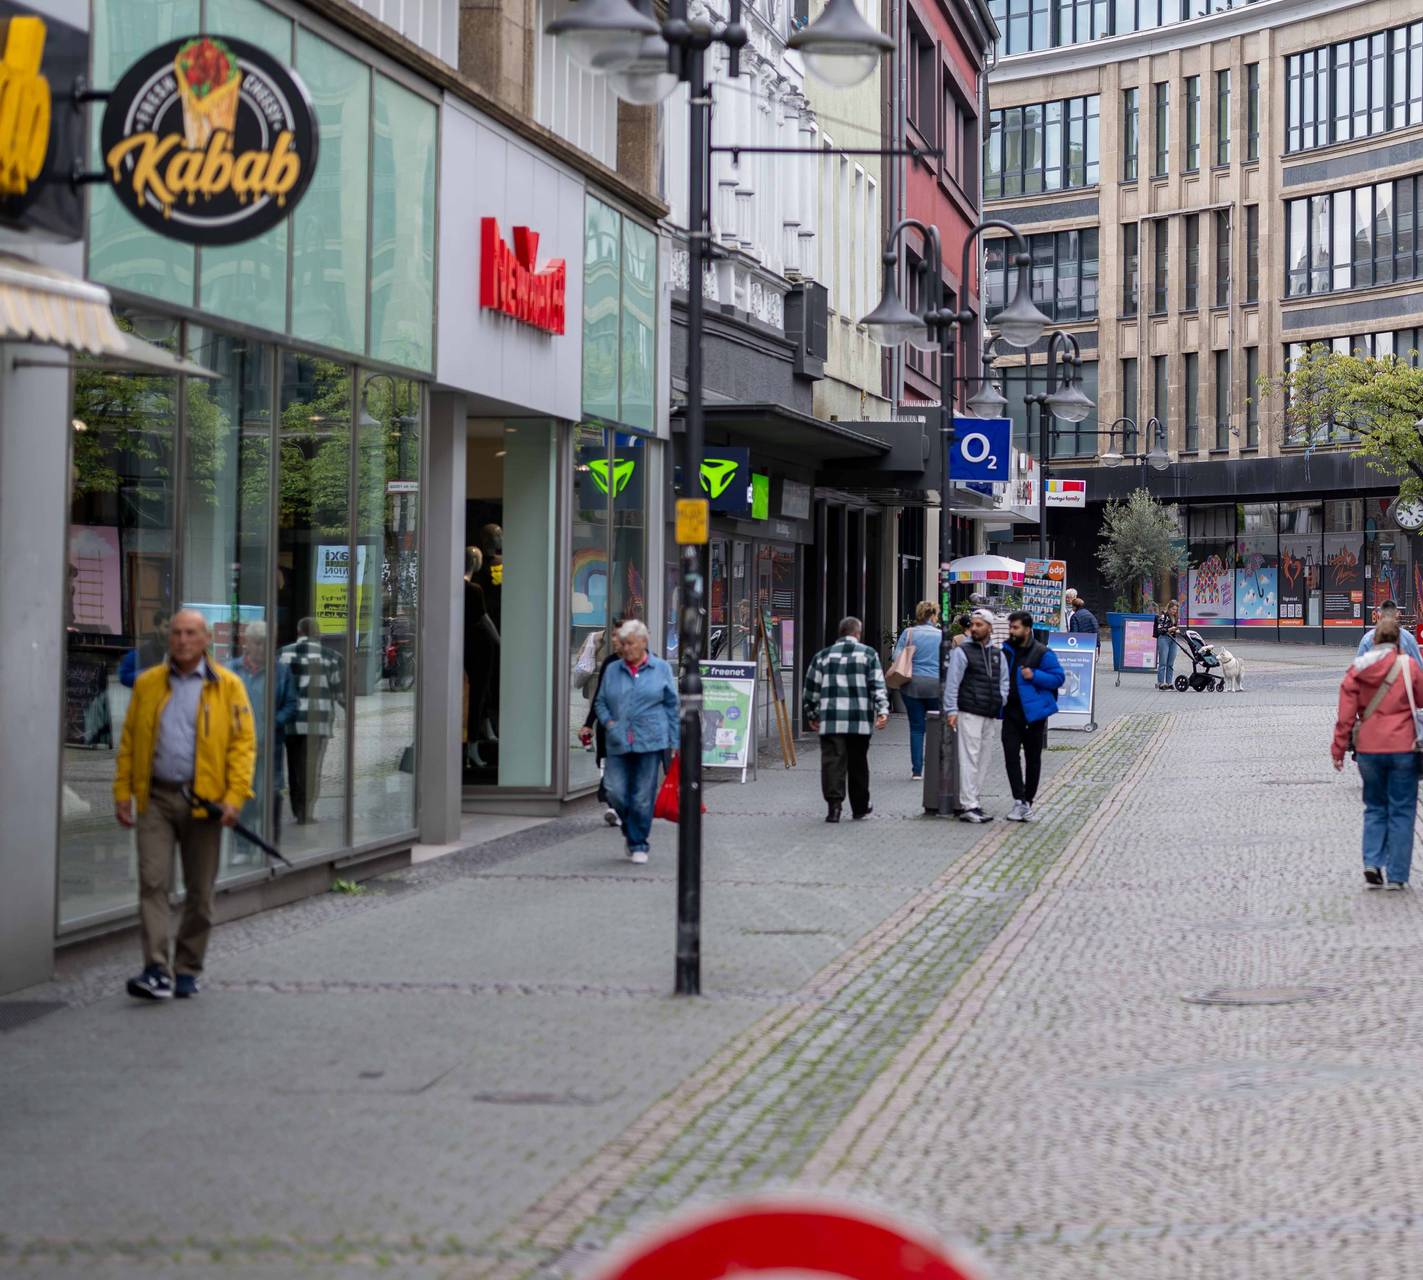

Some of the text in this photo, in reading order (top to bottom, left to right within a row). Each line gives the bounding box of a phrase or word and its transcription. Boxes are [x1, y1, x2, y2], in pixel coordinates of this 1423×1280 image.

[136, 75, 176, 123] FRESH
[107, 129, 300, 212] Kabab
[961, 432, 997, 469] O2
[711, 667, 745, 677] freenet
